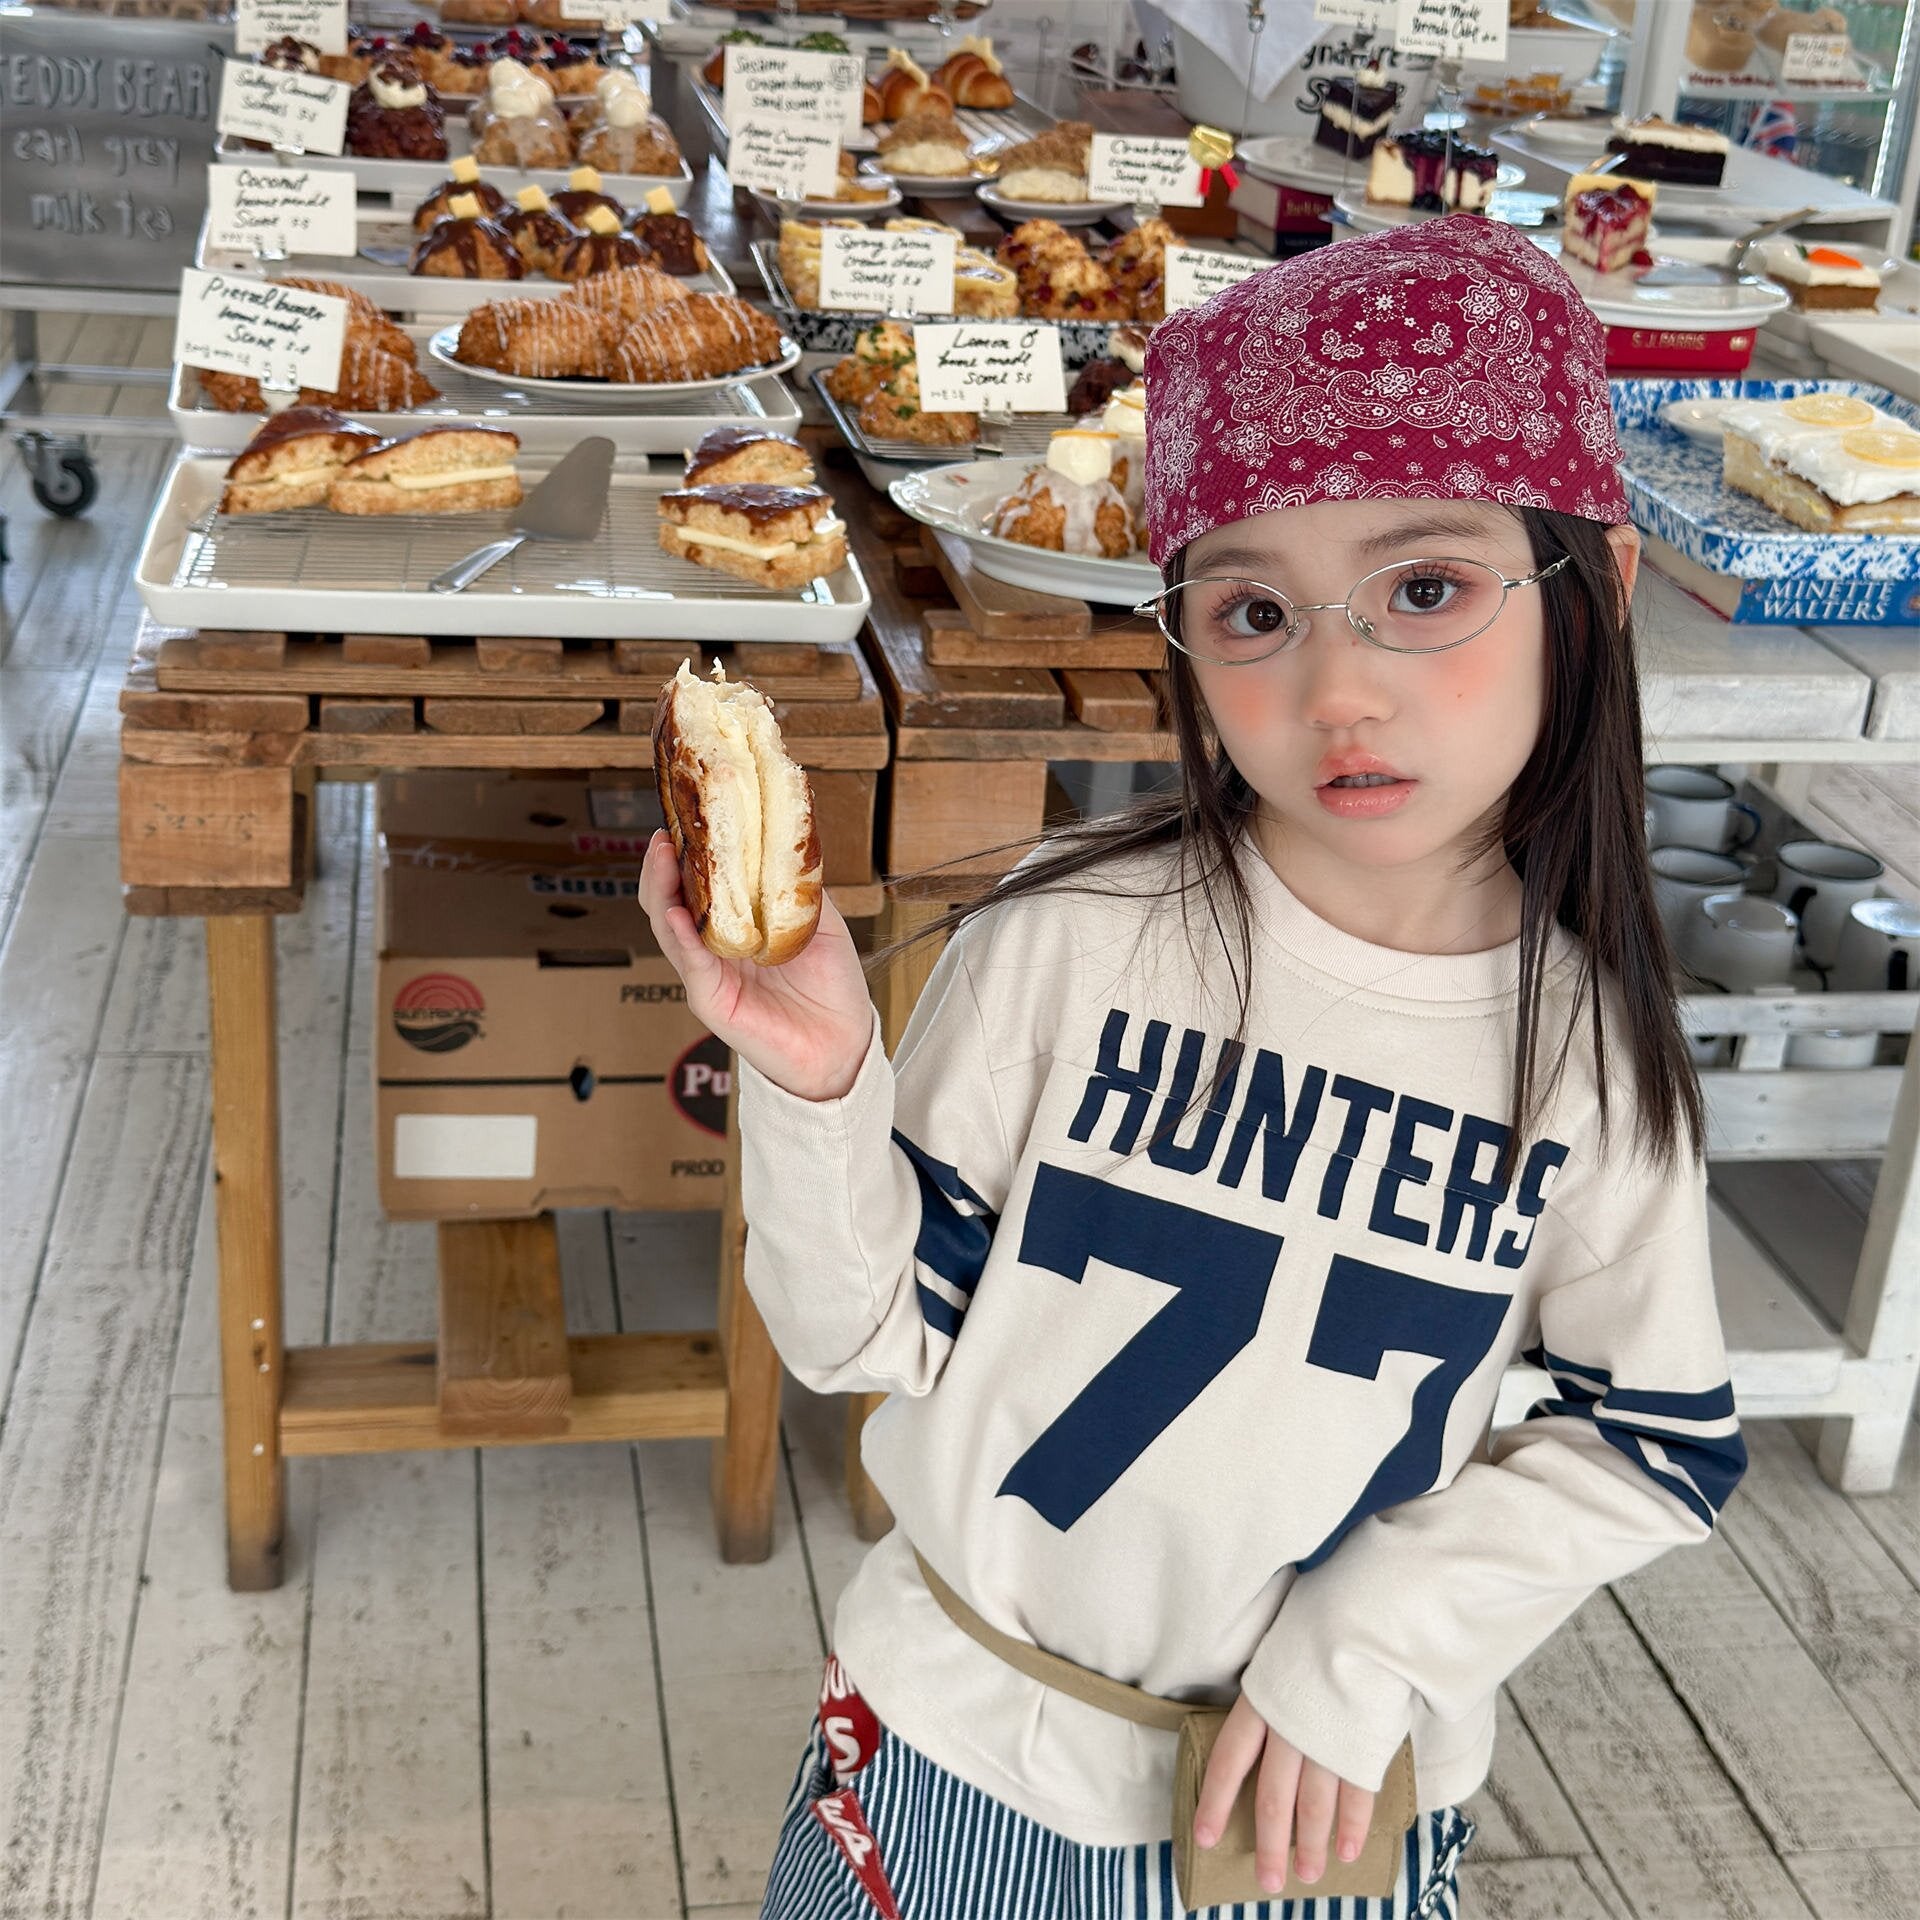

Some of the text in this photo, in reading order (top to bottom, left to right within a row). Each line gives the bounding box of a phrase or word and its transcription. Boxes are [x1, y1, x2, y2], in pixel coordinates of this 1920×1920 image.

[113, 58, 210, 121] BEAR
[236, 168, 309, 191] Coconut
[952, 328, 1011, 350] Lemon
[1766, 578, 1895, 600] MINETTE
[1764, 600, 1889, 621] WALTERS
[620, 983, 687, 1003] PREMI
[683, 1063, 732, 1097] Pu
[1067, 1008, 1570, 1269] HUNTERS
[671, 1159, 725, 1177] PROD
[994, 1161, 1513, 1576] 77
